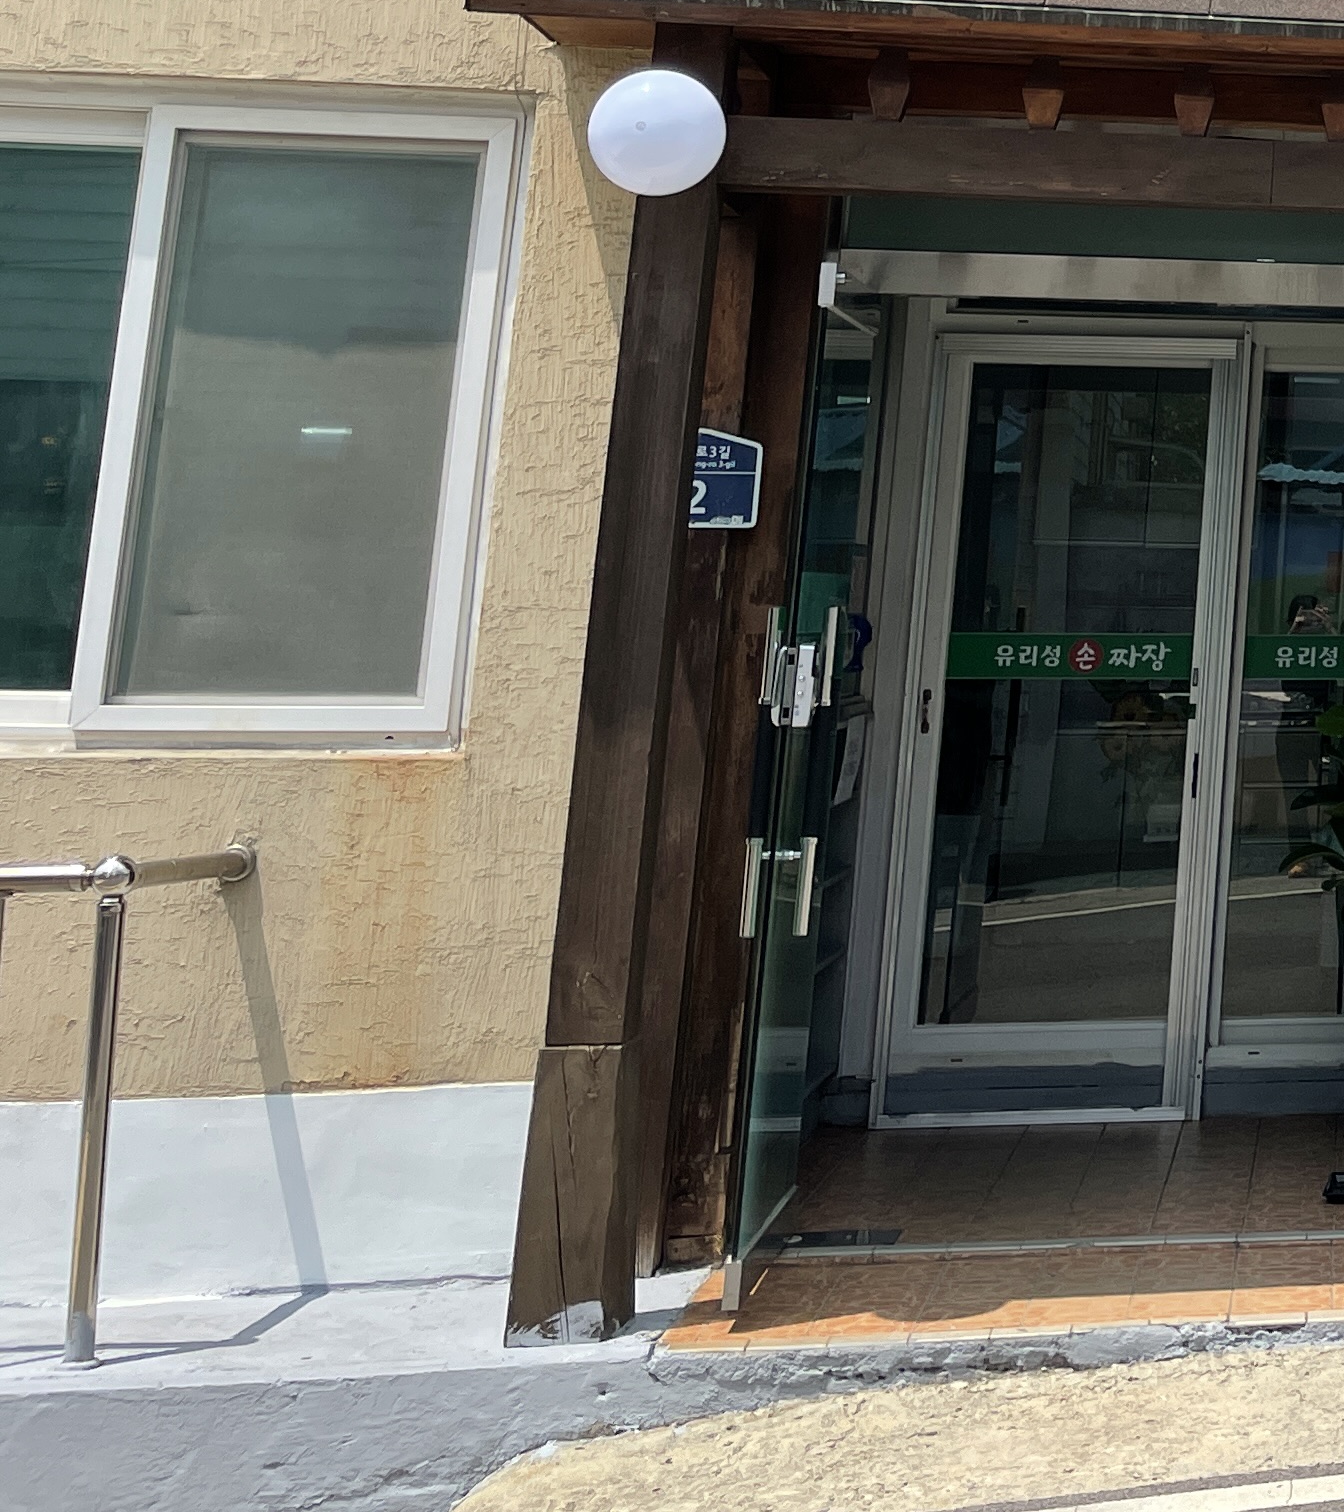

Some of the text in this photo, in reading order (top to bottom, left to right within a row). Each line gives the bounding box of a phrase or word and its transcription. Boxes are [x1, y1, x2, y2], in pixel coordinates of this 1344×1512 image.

[994, 641, 1172, 672] 유리성 손 짜장
[1274, 645, 1339, 669] 유리성
